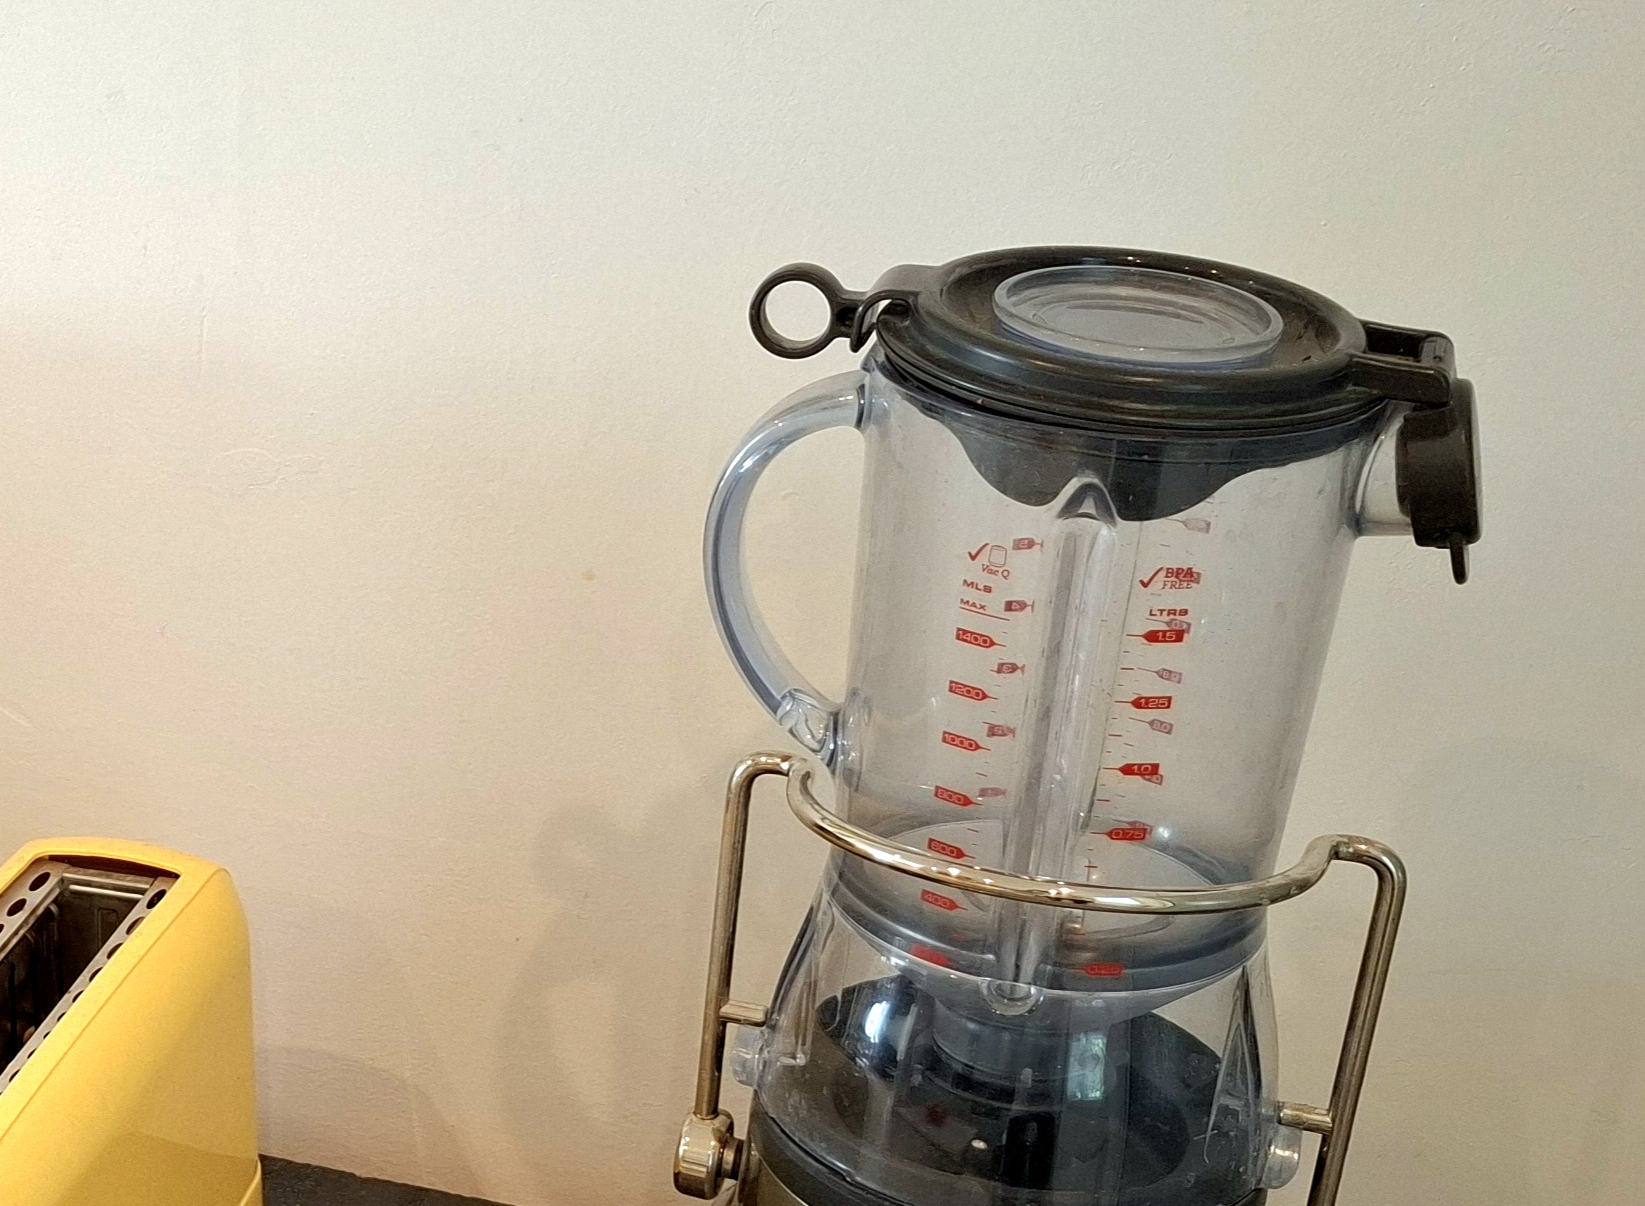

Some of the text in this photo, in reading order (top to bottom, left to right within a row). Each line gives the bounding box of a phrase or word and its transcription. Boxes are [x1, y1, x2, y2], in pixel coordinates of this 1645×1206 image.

[981, 563, 1011, 581] Vac Q
[1163, 566, 1195, 579] BPA
[1160, 580, 1194, 591] FREE
[959, 597, 988, 612] MAX
[957, 629, 991, 647] 1400
[1155, 631, 1177, 641] 1.5
[950, 682, 983, 701] 1200
[1138, 698, 1169, 708] 1.25
[944, 733, 976, 750] 1000
[1131, 764, 1152, 774] 1.0
[1111, 830, 1144, 839] 0.75
